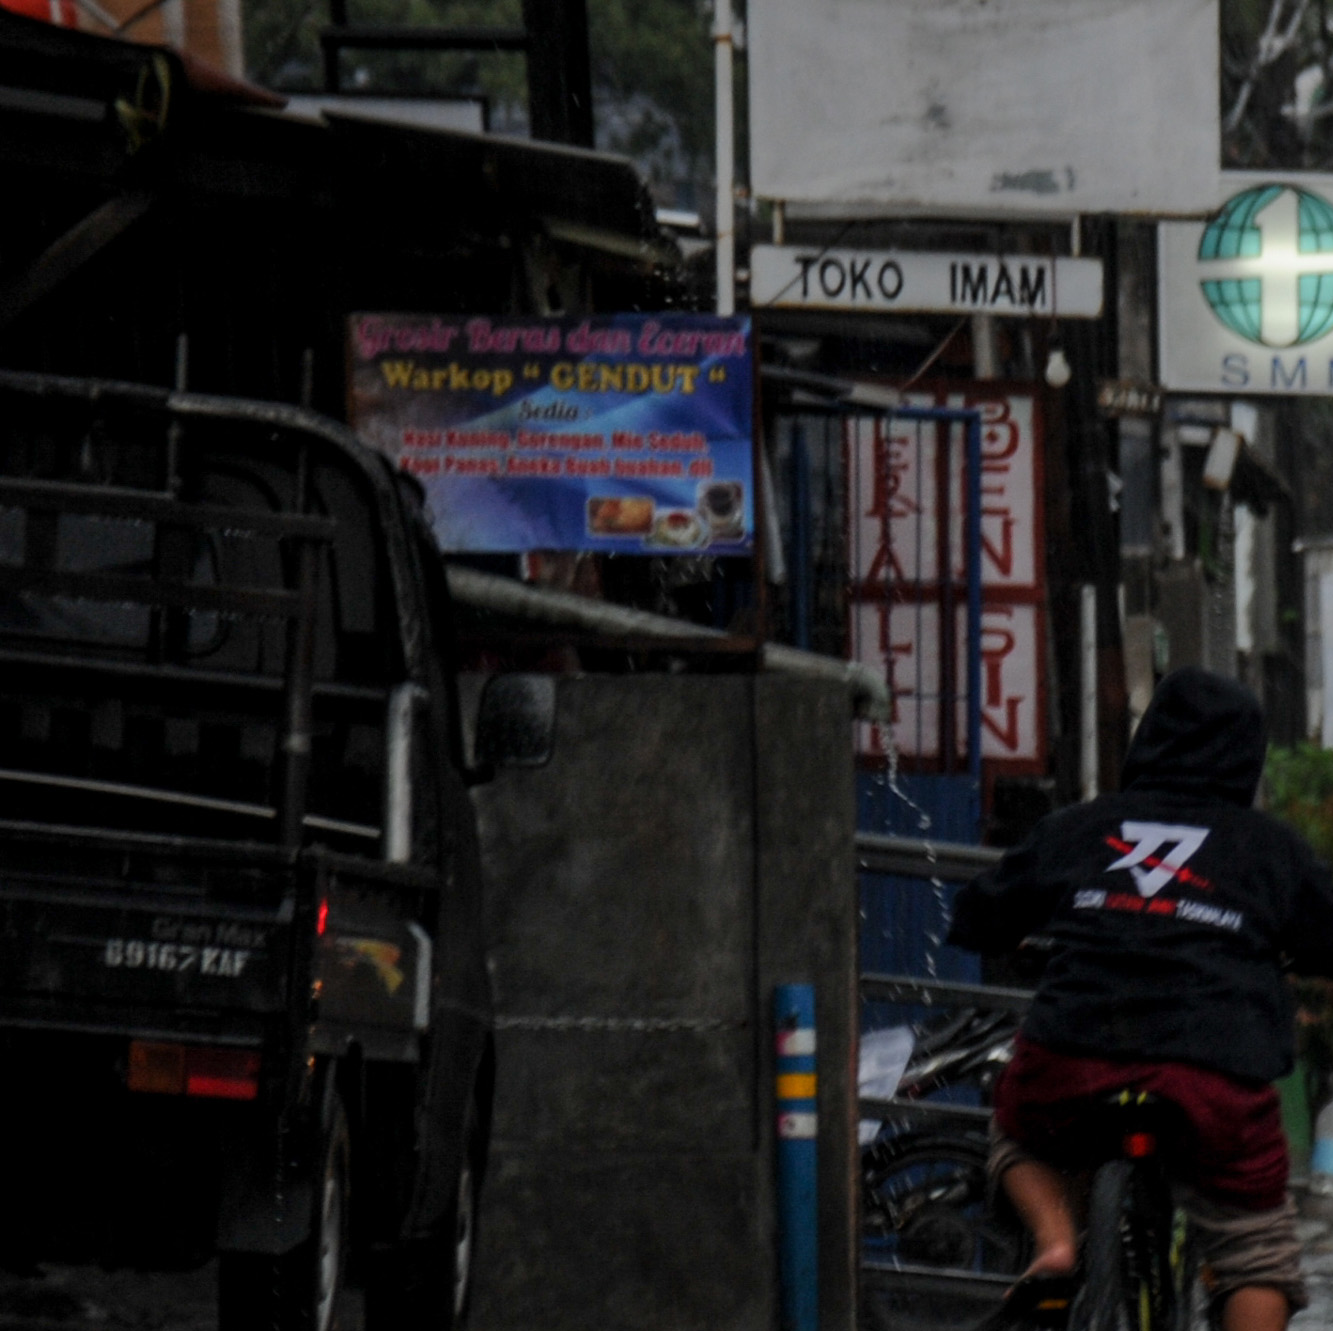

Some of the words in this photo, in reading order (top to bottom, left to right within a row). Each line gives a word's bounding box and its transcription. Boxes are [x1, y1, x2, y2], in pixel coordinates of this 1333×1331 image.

[795, 256, 904, 299] TOKO
[950, 261, 1046, 307] IMAM
[355, 316, 461, 359] Grosir
[465, 317, 561, 354] Beras
[566, 320, 634, 355] dan
[637, 320, 748, 358] Eceran
[380, 360, 514, 396] Warkop
